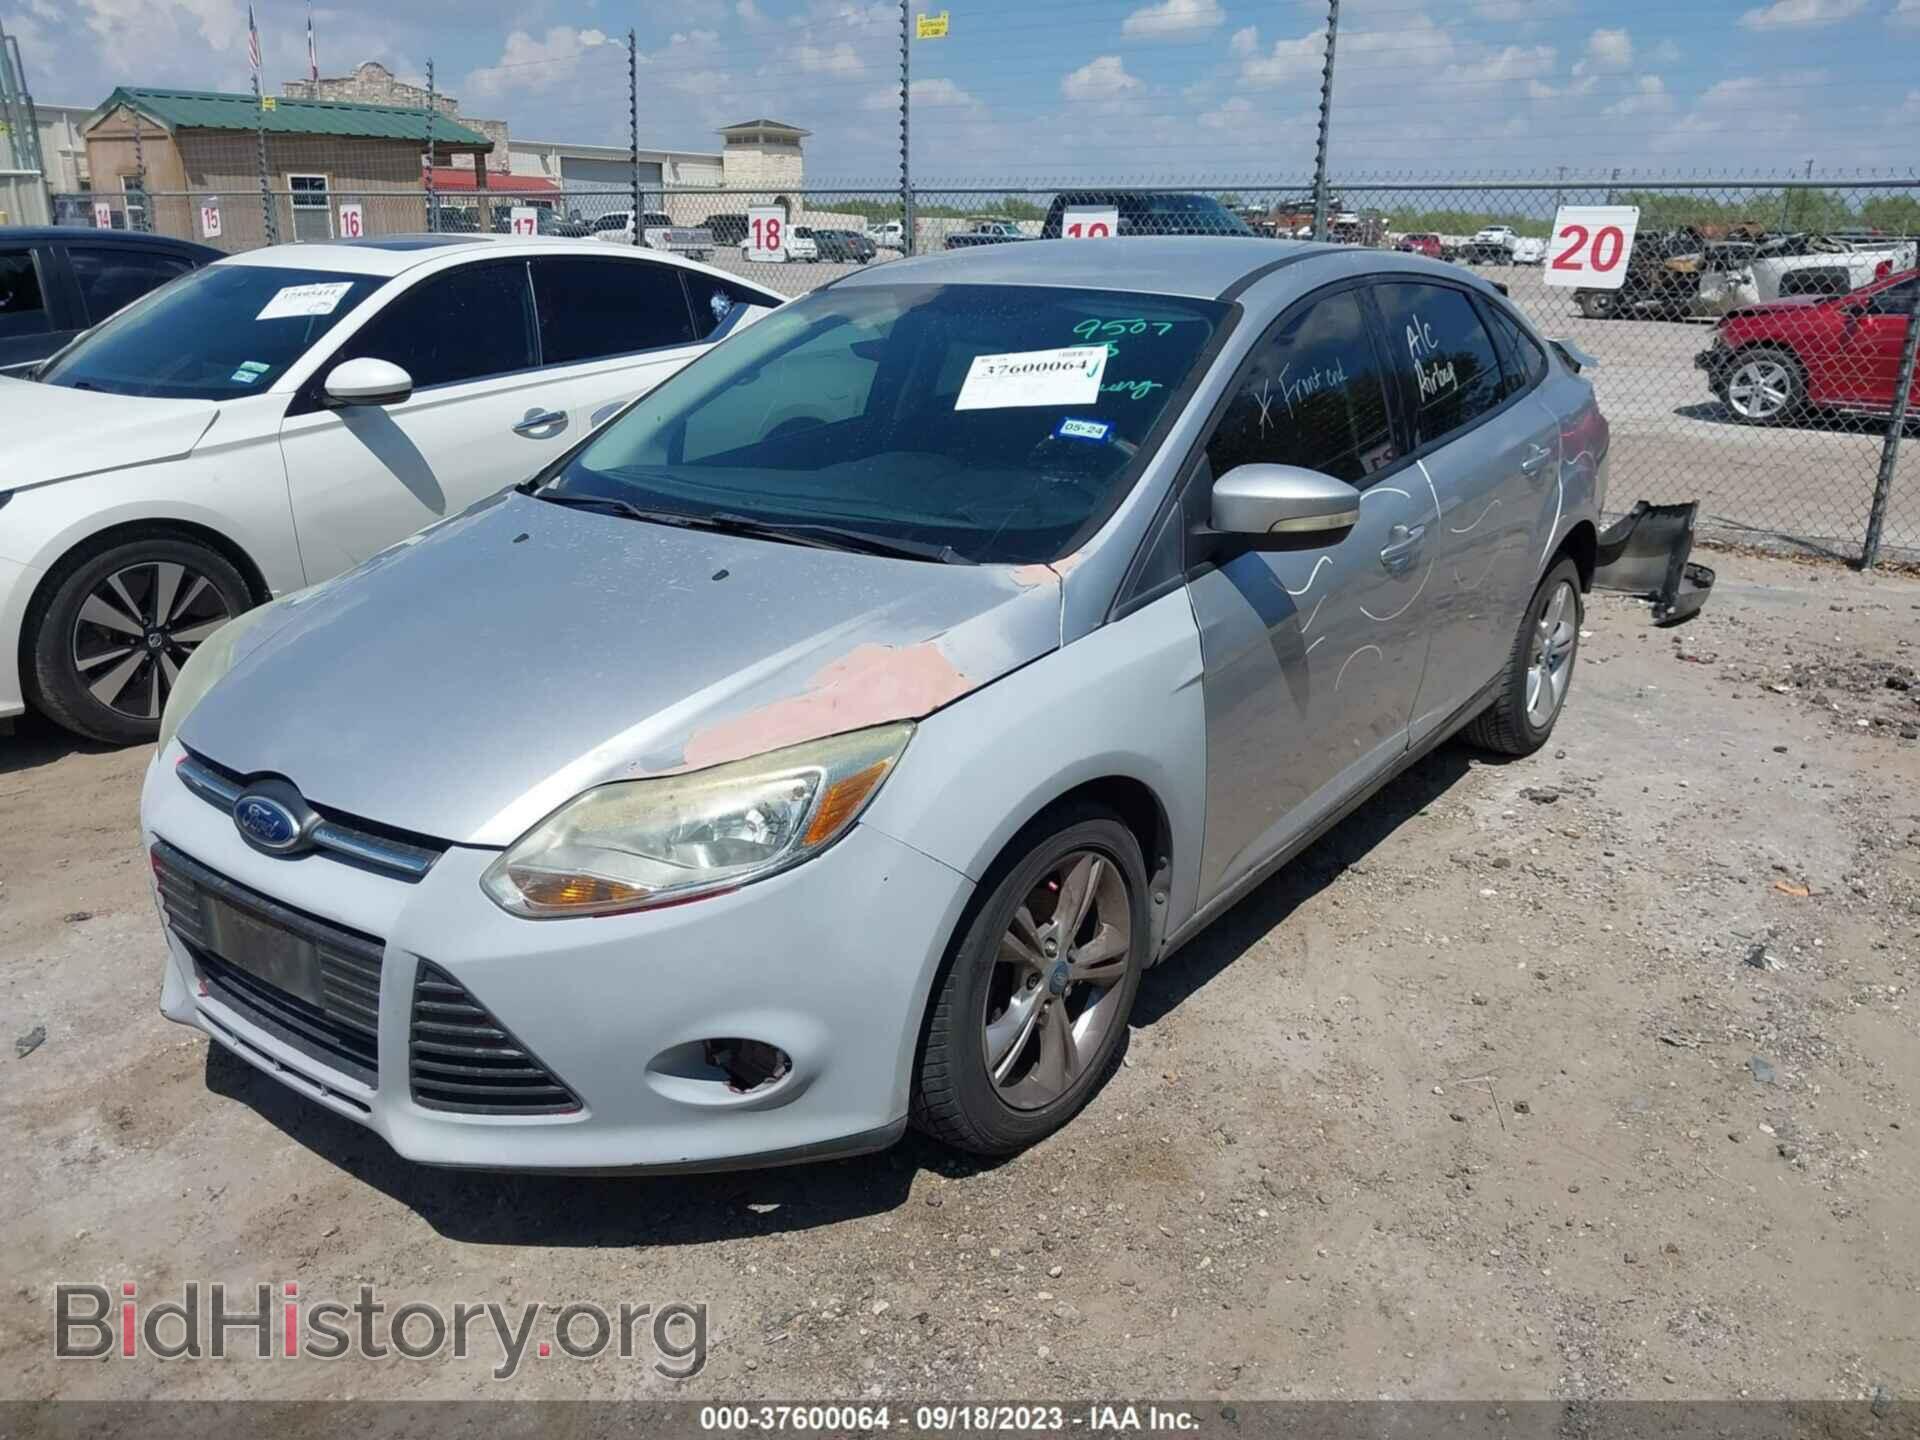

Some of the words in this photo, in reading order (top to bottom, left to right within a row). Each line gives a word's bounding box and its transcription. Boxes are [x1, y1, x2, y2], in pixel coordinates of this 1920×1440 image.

[204, 208, 218, 229] 15
[342, 211, 360, 237] 16
[513, 218, 534, 235] 17
[751, 218, 780, 251] 18
[1551, 224, 1625, 273] 20
[1073, 318, 1174, 340] 9507
[985, 358, 1088, 376] 37600064
[1065, 422, 1104, 435] 05-24
